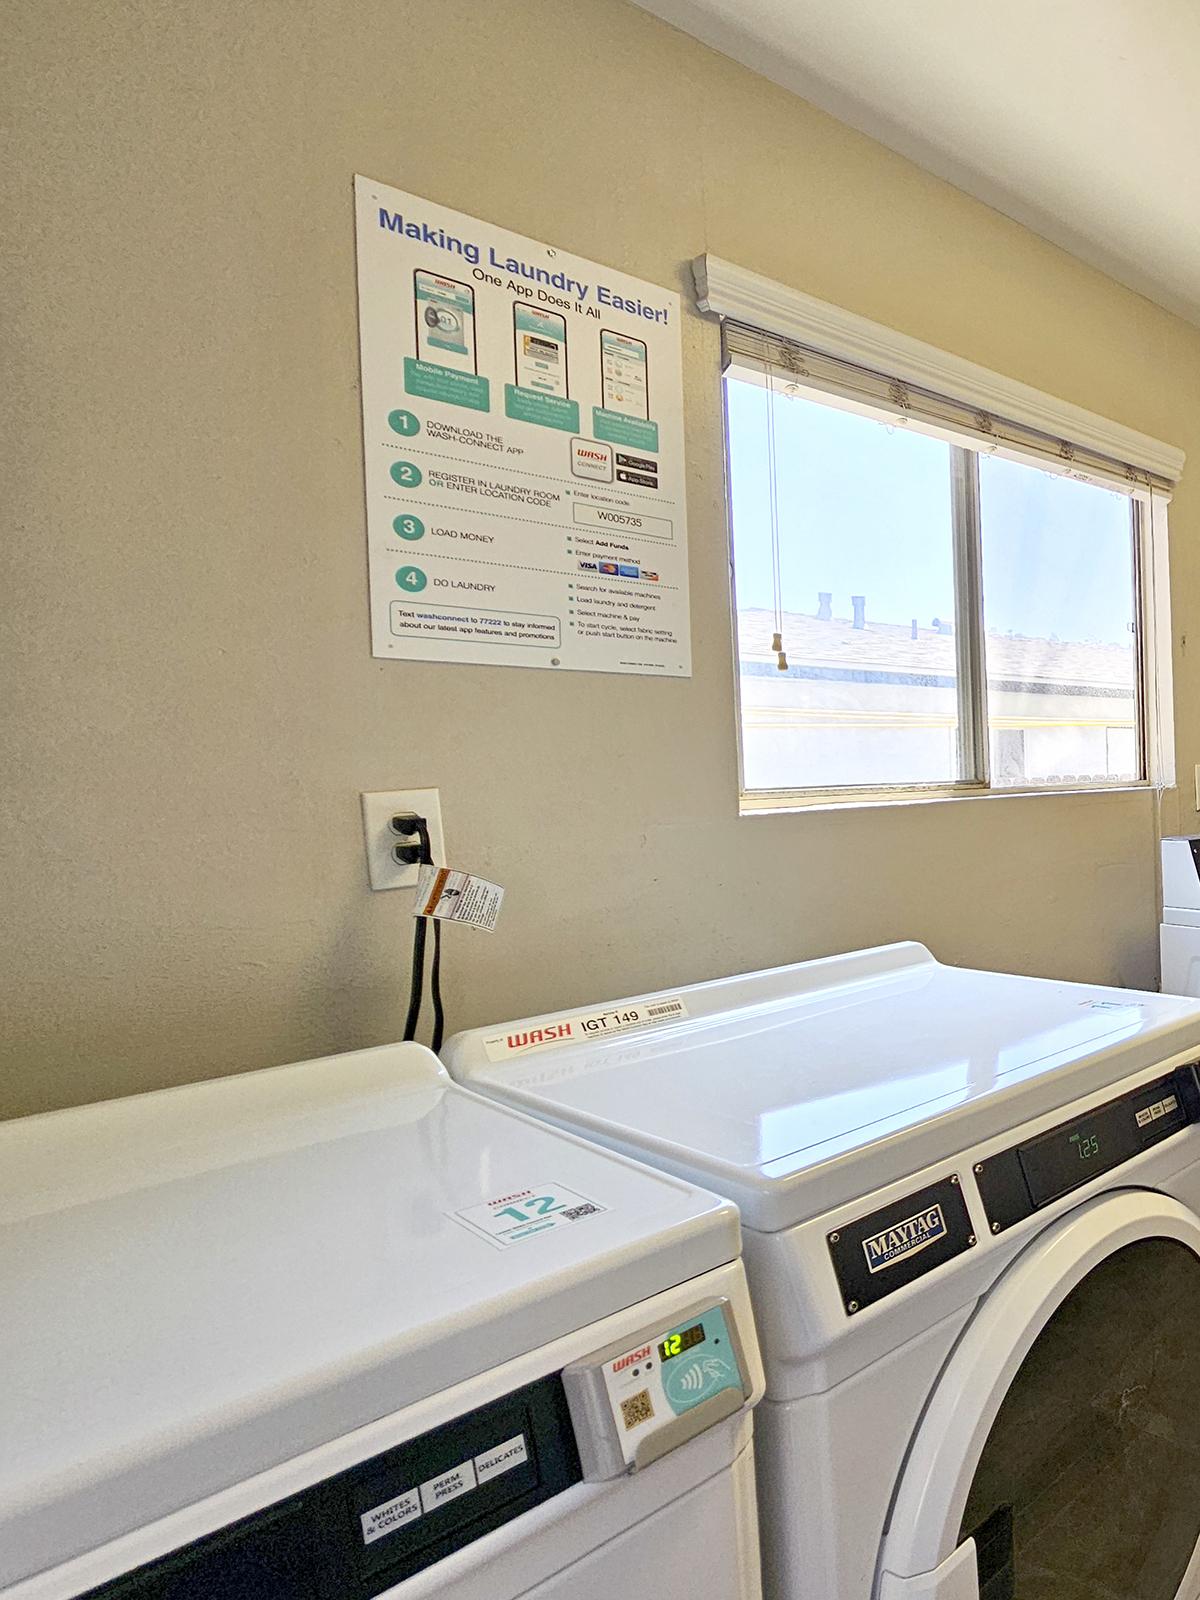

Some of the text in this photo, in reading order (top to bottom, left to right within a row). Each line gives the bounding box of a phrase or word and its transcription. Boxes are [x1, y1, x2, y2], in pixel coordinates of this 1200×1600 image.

[379, 208, 668, 325] Making Laundry Easier!
[472, 268, 502, 287] One
[507, 280, 533, 298] App
[537, 289, 571, 310] Does
[575, 301, 582, 314] It
[586, 307, 601, 319] All
[399, 415, 408, 429] 1
[426, 429, 524, 455] WASH-CONNECT APP
[427, 421, 503, 444] DOWNLOAD THE
[577, 449, 607, 461] WASH
[400, 466, 413, 481] 2
[577, 461, 607, 471] CONNECT
[429, 470, 560, 501] REGISTER IN LAUNDRY ROOM
[429, 479, 552, 508] OR ENTER LOCATION CODE
[573, 490, 630, 506] Enter location code
[403, 519, 415, 534] 3
[597, 511, 642, 527] W005735
[431, 528, 494, 543] LOAD MONEY
[575, 536, 594, 545] Select
[609, 543, 629, 551] Funds
[580, 561, 598, 570] VISA
[592, 553, 618, 561] payment
[406, 571, 417, 586] 4
[433, 578, 496, 592] DO LAUNDRY
[576, 583, 598, 592] Search
[577, 596, 592, 604] Load
[594, 599, 615, 607] laundry
[398, 610, 415, 618] Text
[417, 612, 469, 623] washconnect
[480, 618, 501, 626] 77222
[512, 621, 525, 629] stay
[527, 623, 556, 631] informed
[577, 609, 596, 617] Select
[597, 612, 622, 620] machine
[400, 621, 422, 629] about
[438, 624, 458, 632] latest
[474, 627, 502, 636] features
[518, 632, 555, 641] promotions
[507, 1023, 572, 1048] WASH
[581, 1016, 607, 1032] IGT
[613, 1010, 639, 1024] 149
[493, 1196, 567, 1222] 12
[868, 1209, 940, 1260] MAYTAG
[884, 1232, 932, 1261] COMMERCIAL
[664, 1334, 682, 1356] 12
[613, 1345, 651, 1373] WASH
[478, 1446, 523, 1473] DELICATES
[435, 1480, 464, 1499] PRESS
[366, 1503, 418, 1536] & COLORS
[370, 1497, 411, 1523] WHITES
